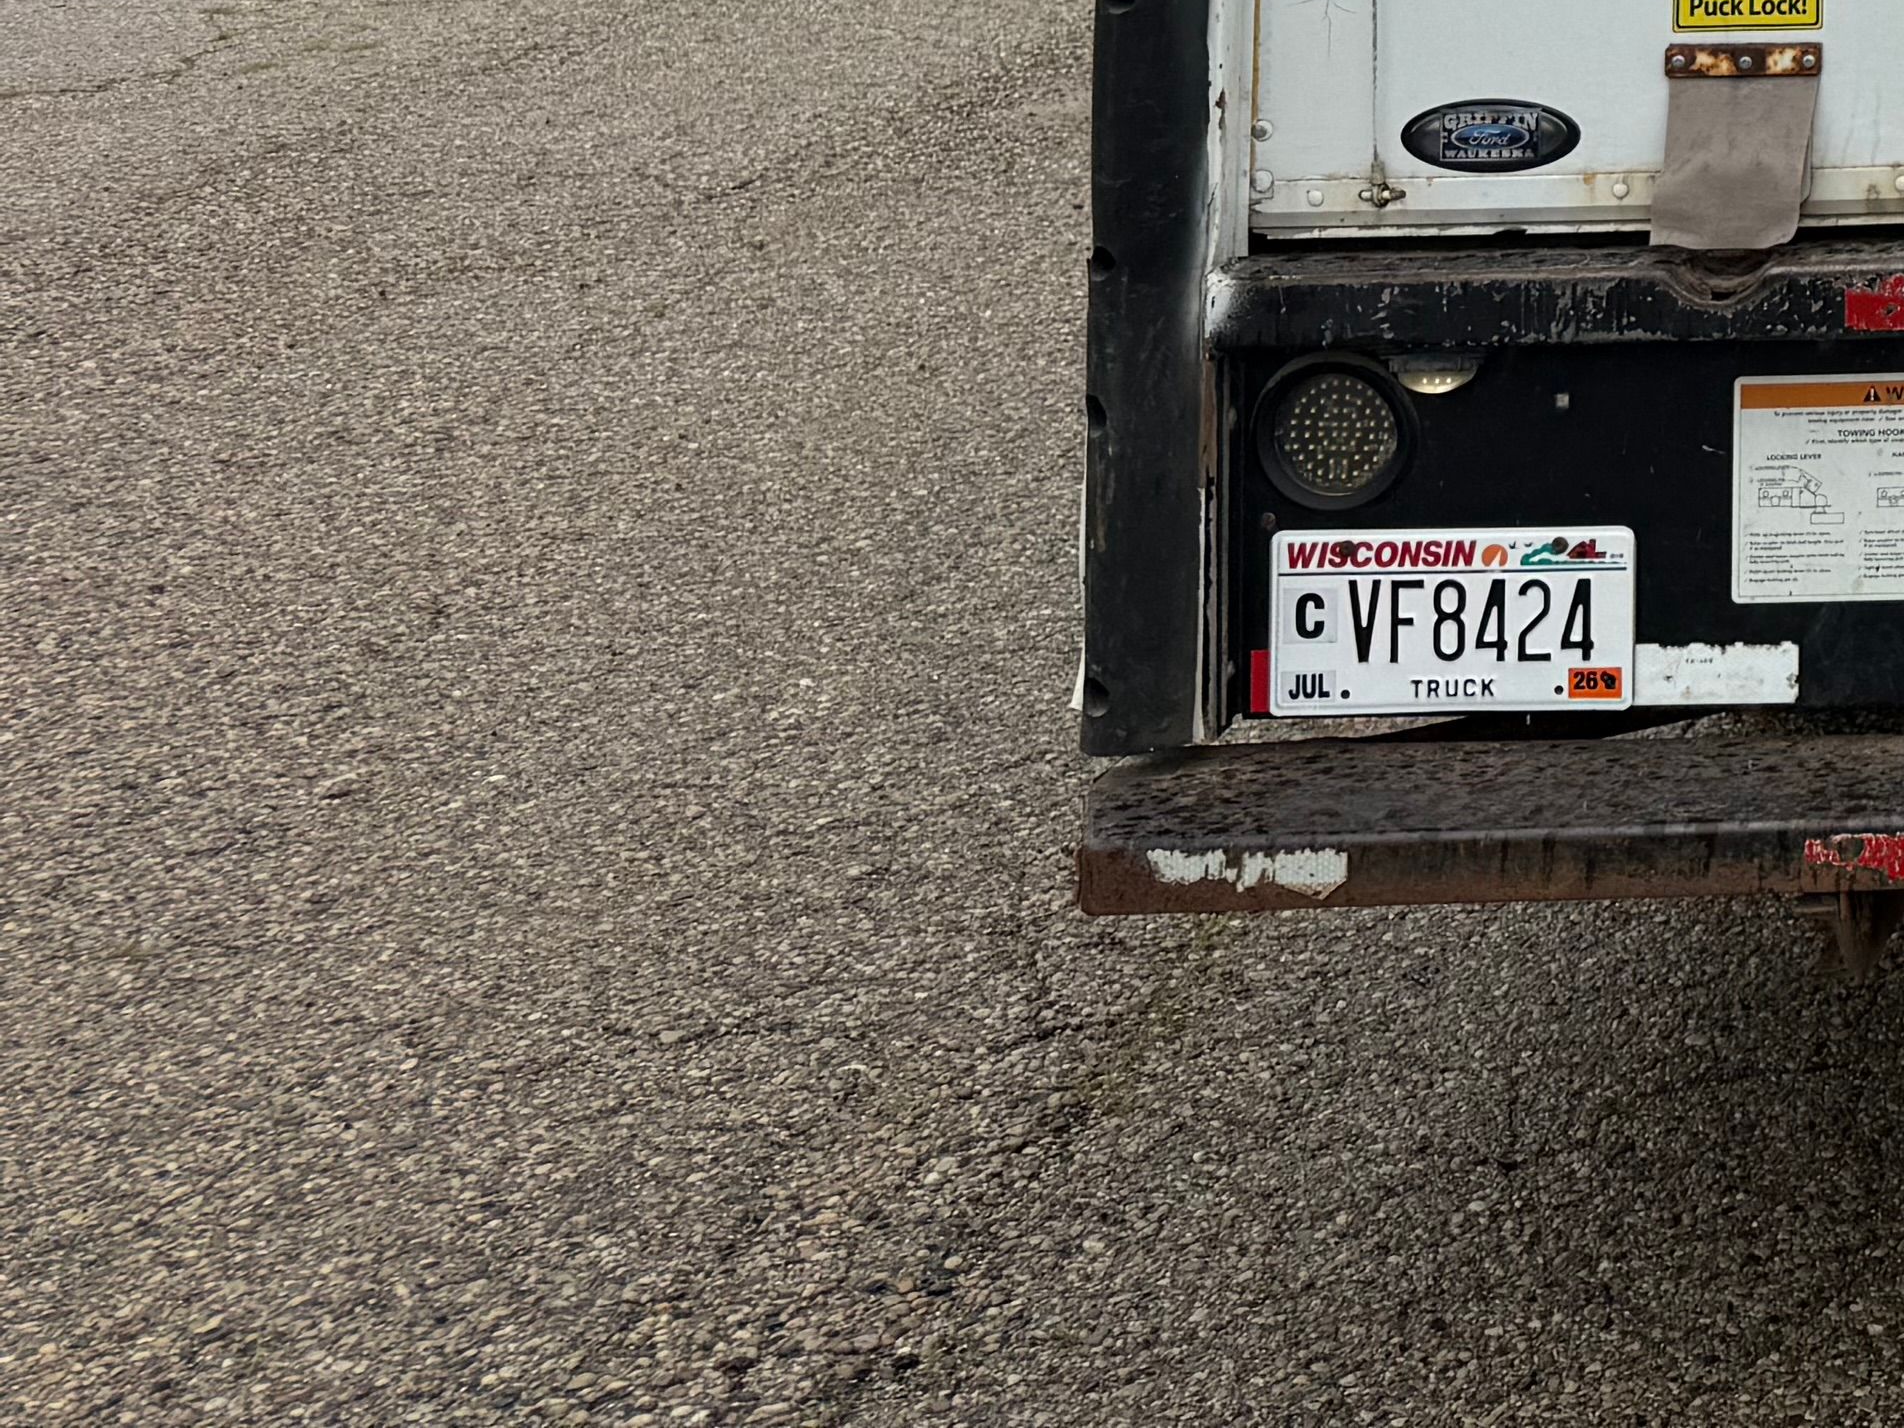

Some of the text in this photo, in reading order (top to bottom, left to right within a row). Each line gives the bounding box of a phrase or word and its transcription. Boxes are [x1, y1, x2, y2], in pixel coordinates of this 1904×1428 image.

[1443, 112, 1539, 132] GRIFFIN
[1468, 129, 1512, 147] Ford
[1287, 540, 1477, 569] WISCONSIN
[1295, 578, 1595, 664] C VF8424
[1288, 673, 1331, 700] JUL
[1410, 677, 1495, 699] TRUCK
[1573, 671, 1599, 690] 26
